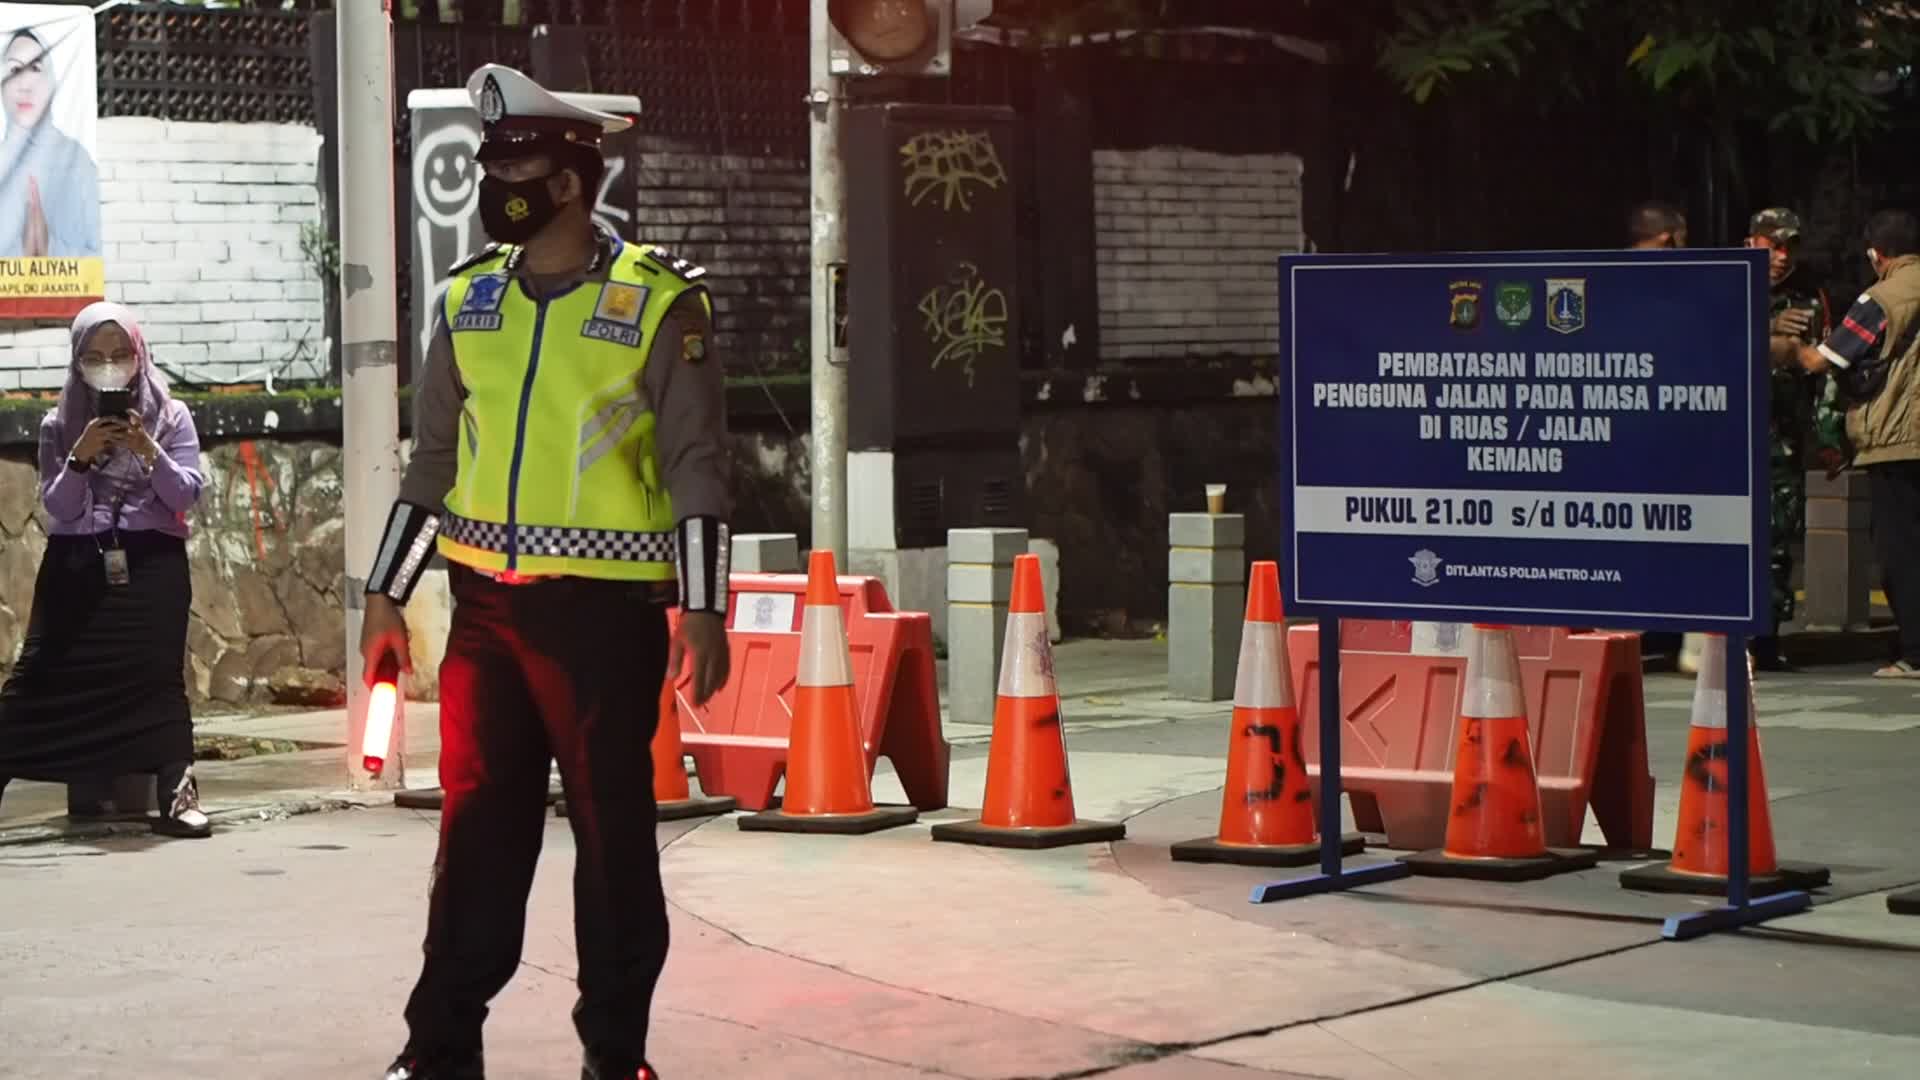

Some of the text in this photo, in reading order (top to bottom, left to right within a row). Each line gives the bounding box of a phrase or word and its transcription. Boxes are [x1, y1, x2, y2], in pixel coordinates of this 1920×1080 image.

[30, 260, 79, 276] ALIYAH
[41, 283, 81, 293] JAKARTA
[587, 321, 636, 345] POLRI
[1378, 352, 1654, 378] PEMBATASAN MOBILITAS
[1313, 383, 1728, 411] PENGGUNA JALAN PADA MASA PPKM
[1420, 415, 1611, 441] DI RUAS / JALAN
[1467, 446, 1563, 472] KEMANG
[1345, 496, 1692, 531] PUKUL 21.00 s/d 04.00 WIB
[1445, 564, 1622, 582] DITLANTAS POLDA METRO JAYA
